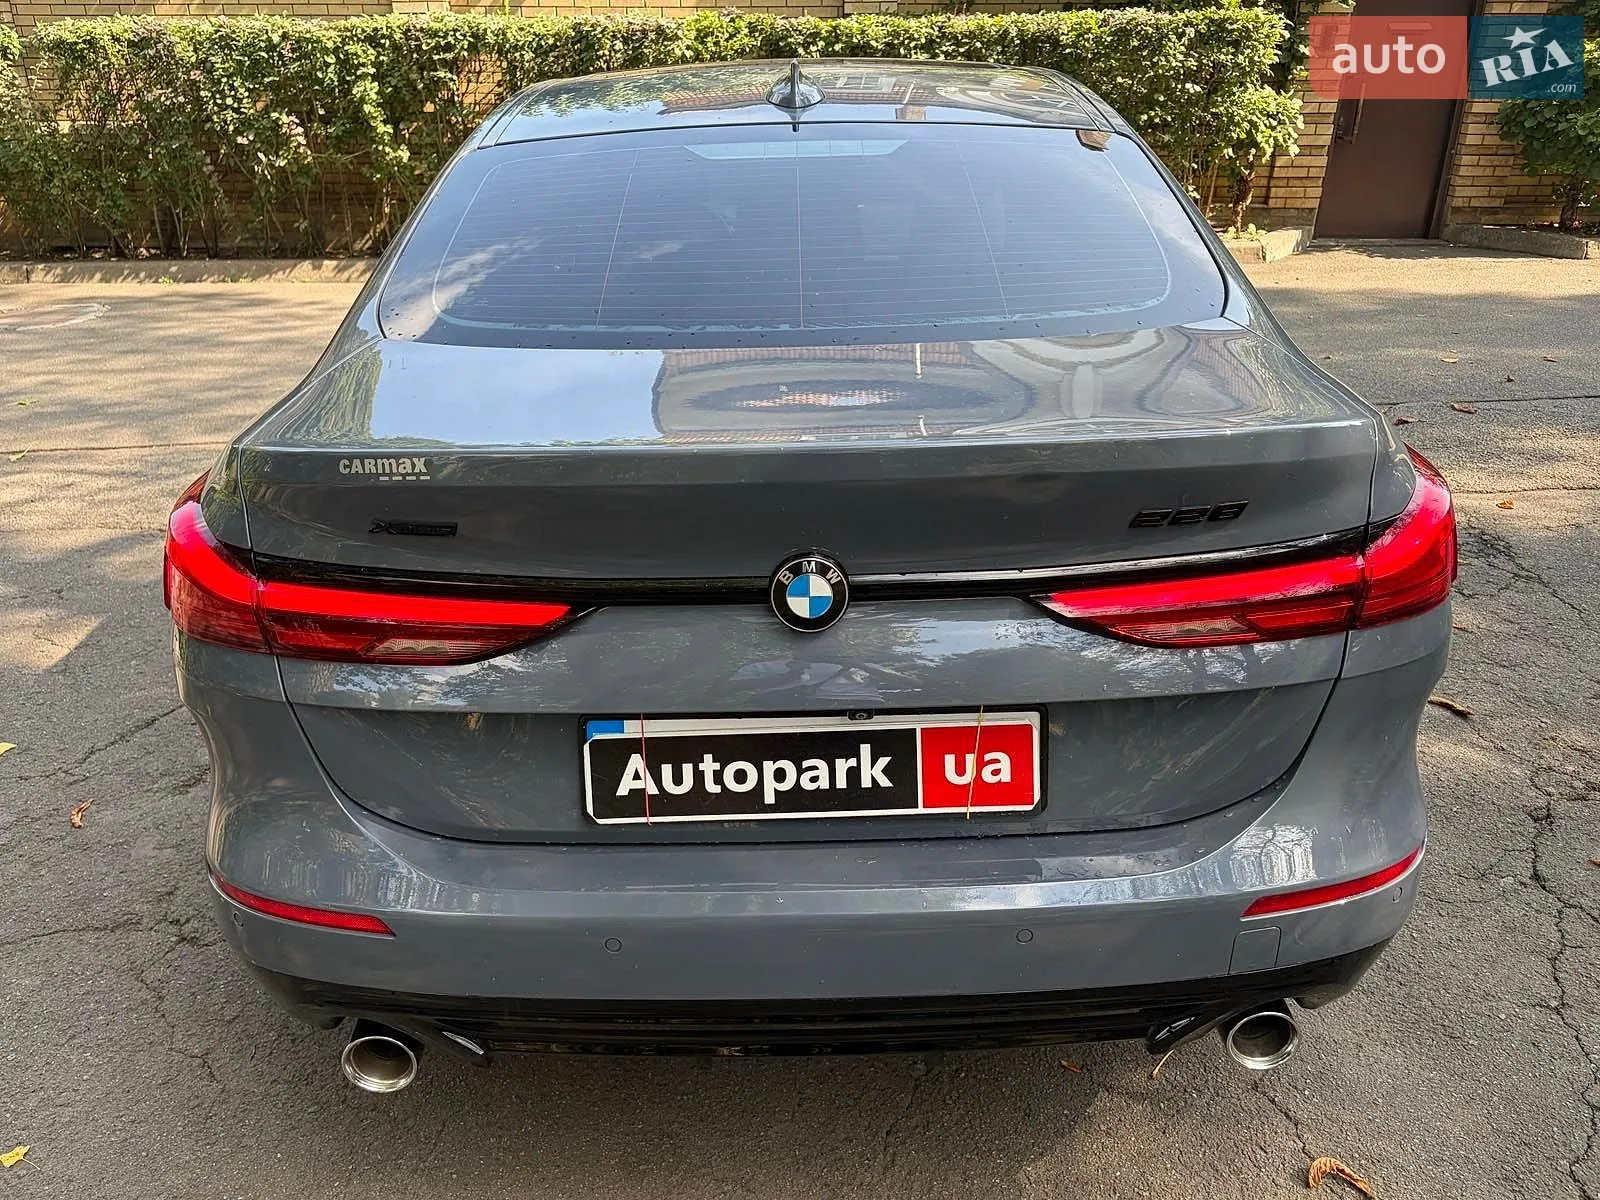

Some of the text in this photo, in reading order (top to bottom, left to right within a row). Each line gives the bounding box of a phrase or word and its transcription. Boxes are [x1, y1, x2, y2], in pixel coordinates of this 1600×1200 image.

[779, 560, 841, 586] BMW
[615, 743, 1012, 805] Autopark ua
